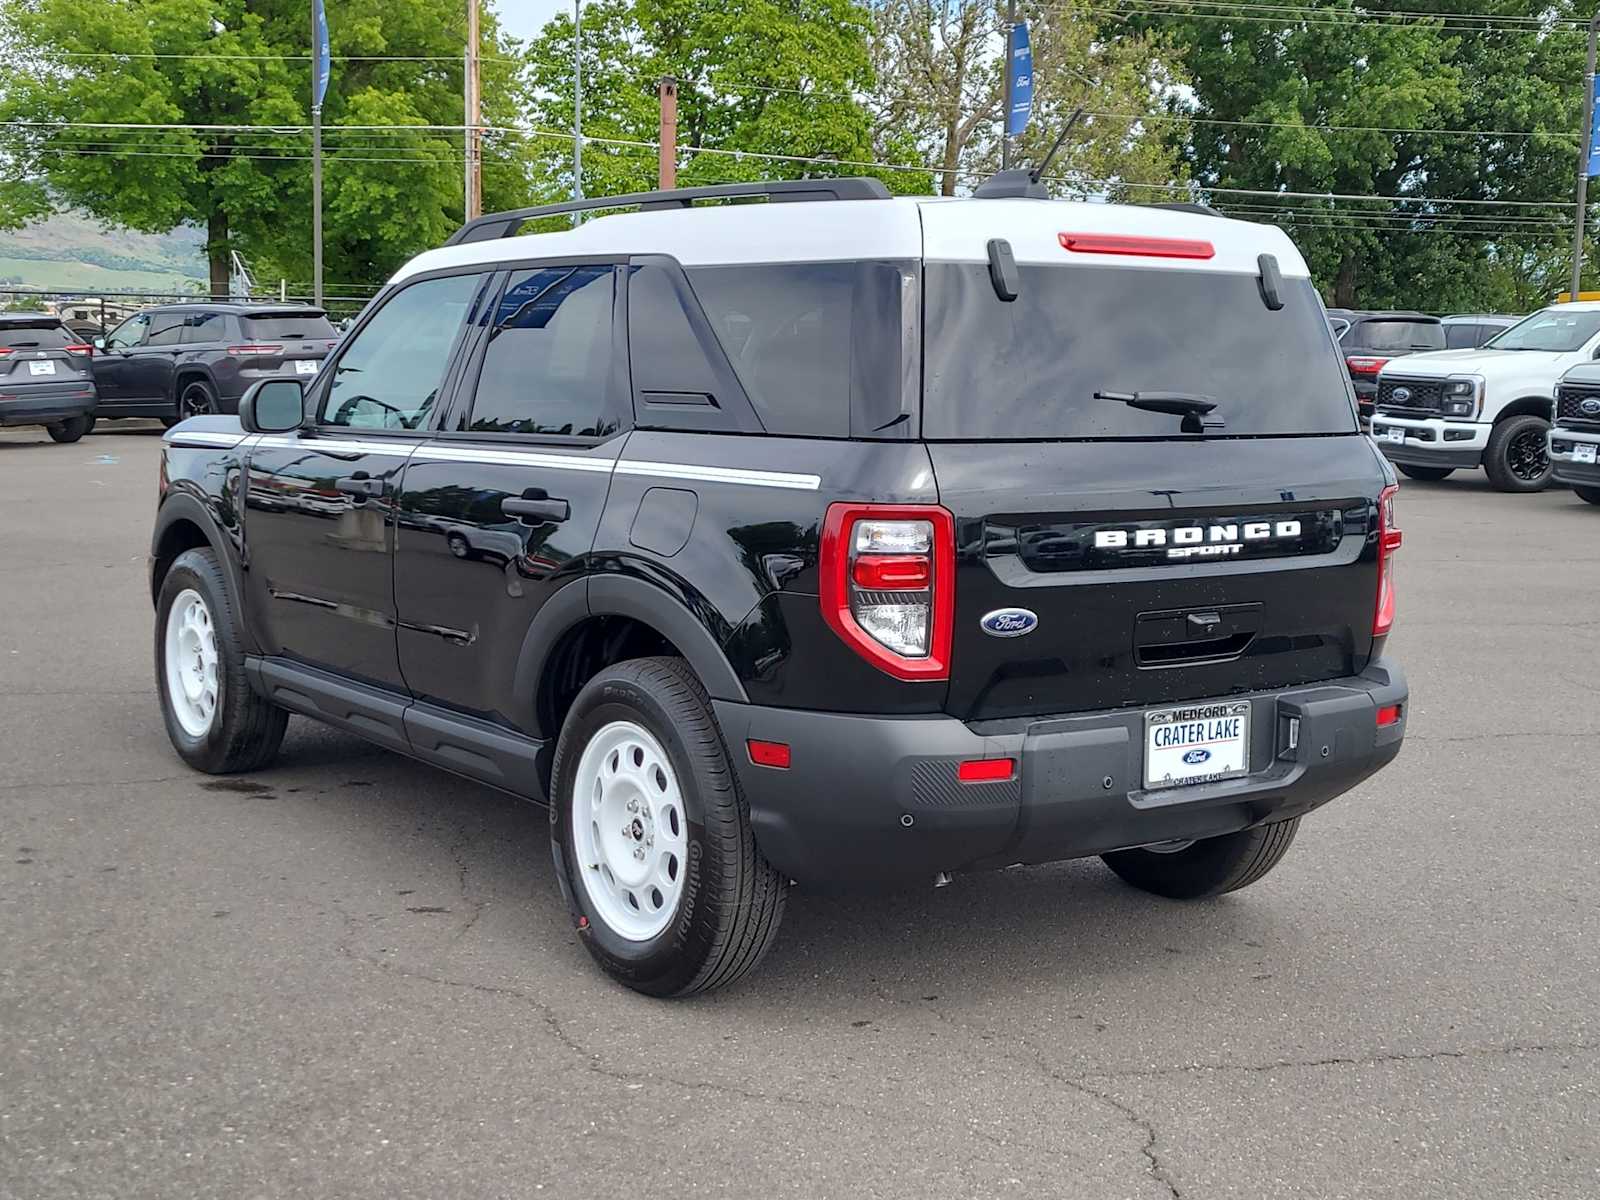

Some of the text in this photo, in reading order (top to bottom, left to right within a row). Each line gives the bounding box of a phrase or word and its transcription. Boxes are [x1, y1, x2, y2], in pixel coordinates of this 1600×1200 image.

[1095, 520, 1302, 548] BRONCO
[1167, 543, 1244, 558] SPORT
[1172, 705, 1228, 722] MEDFORD
[1154, 718, 1240, 747] CRATER LAKE
